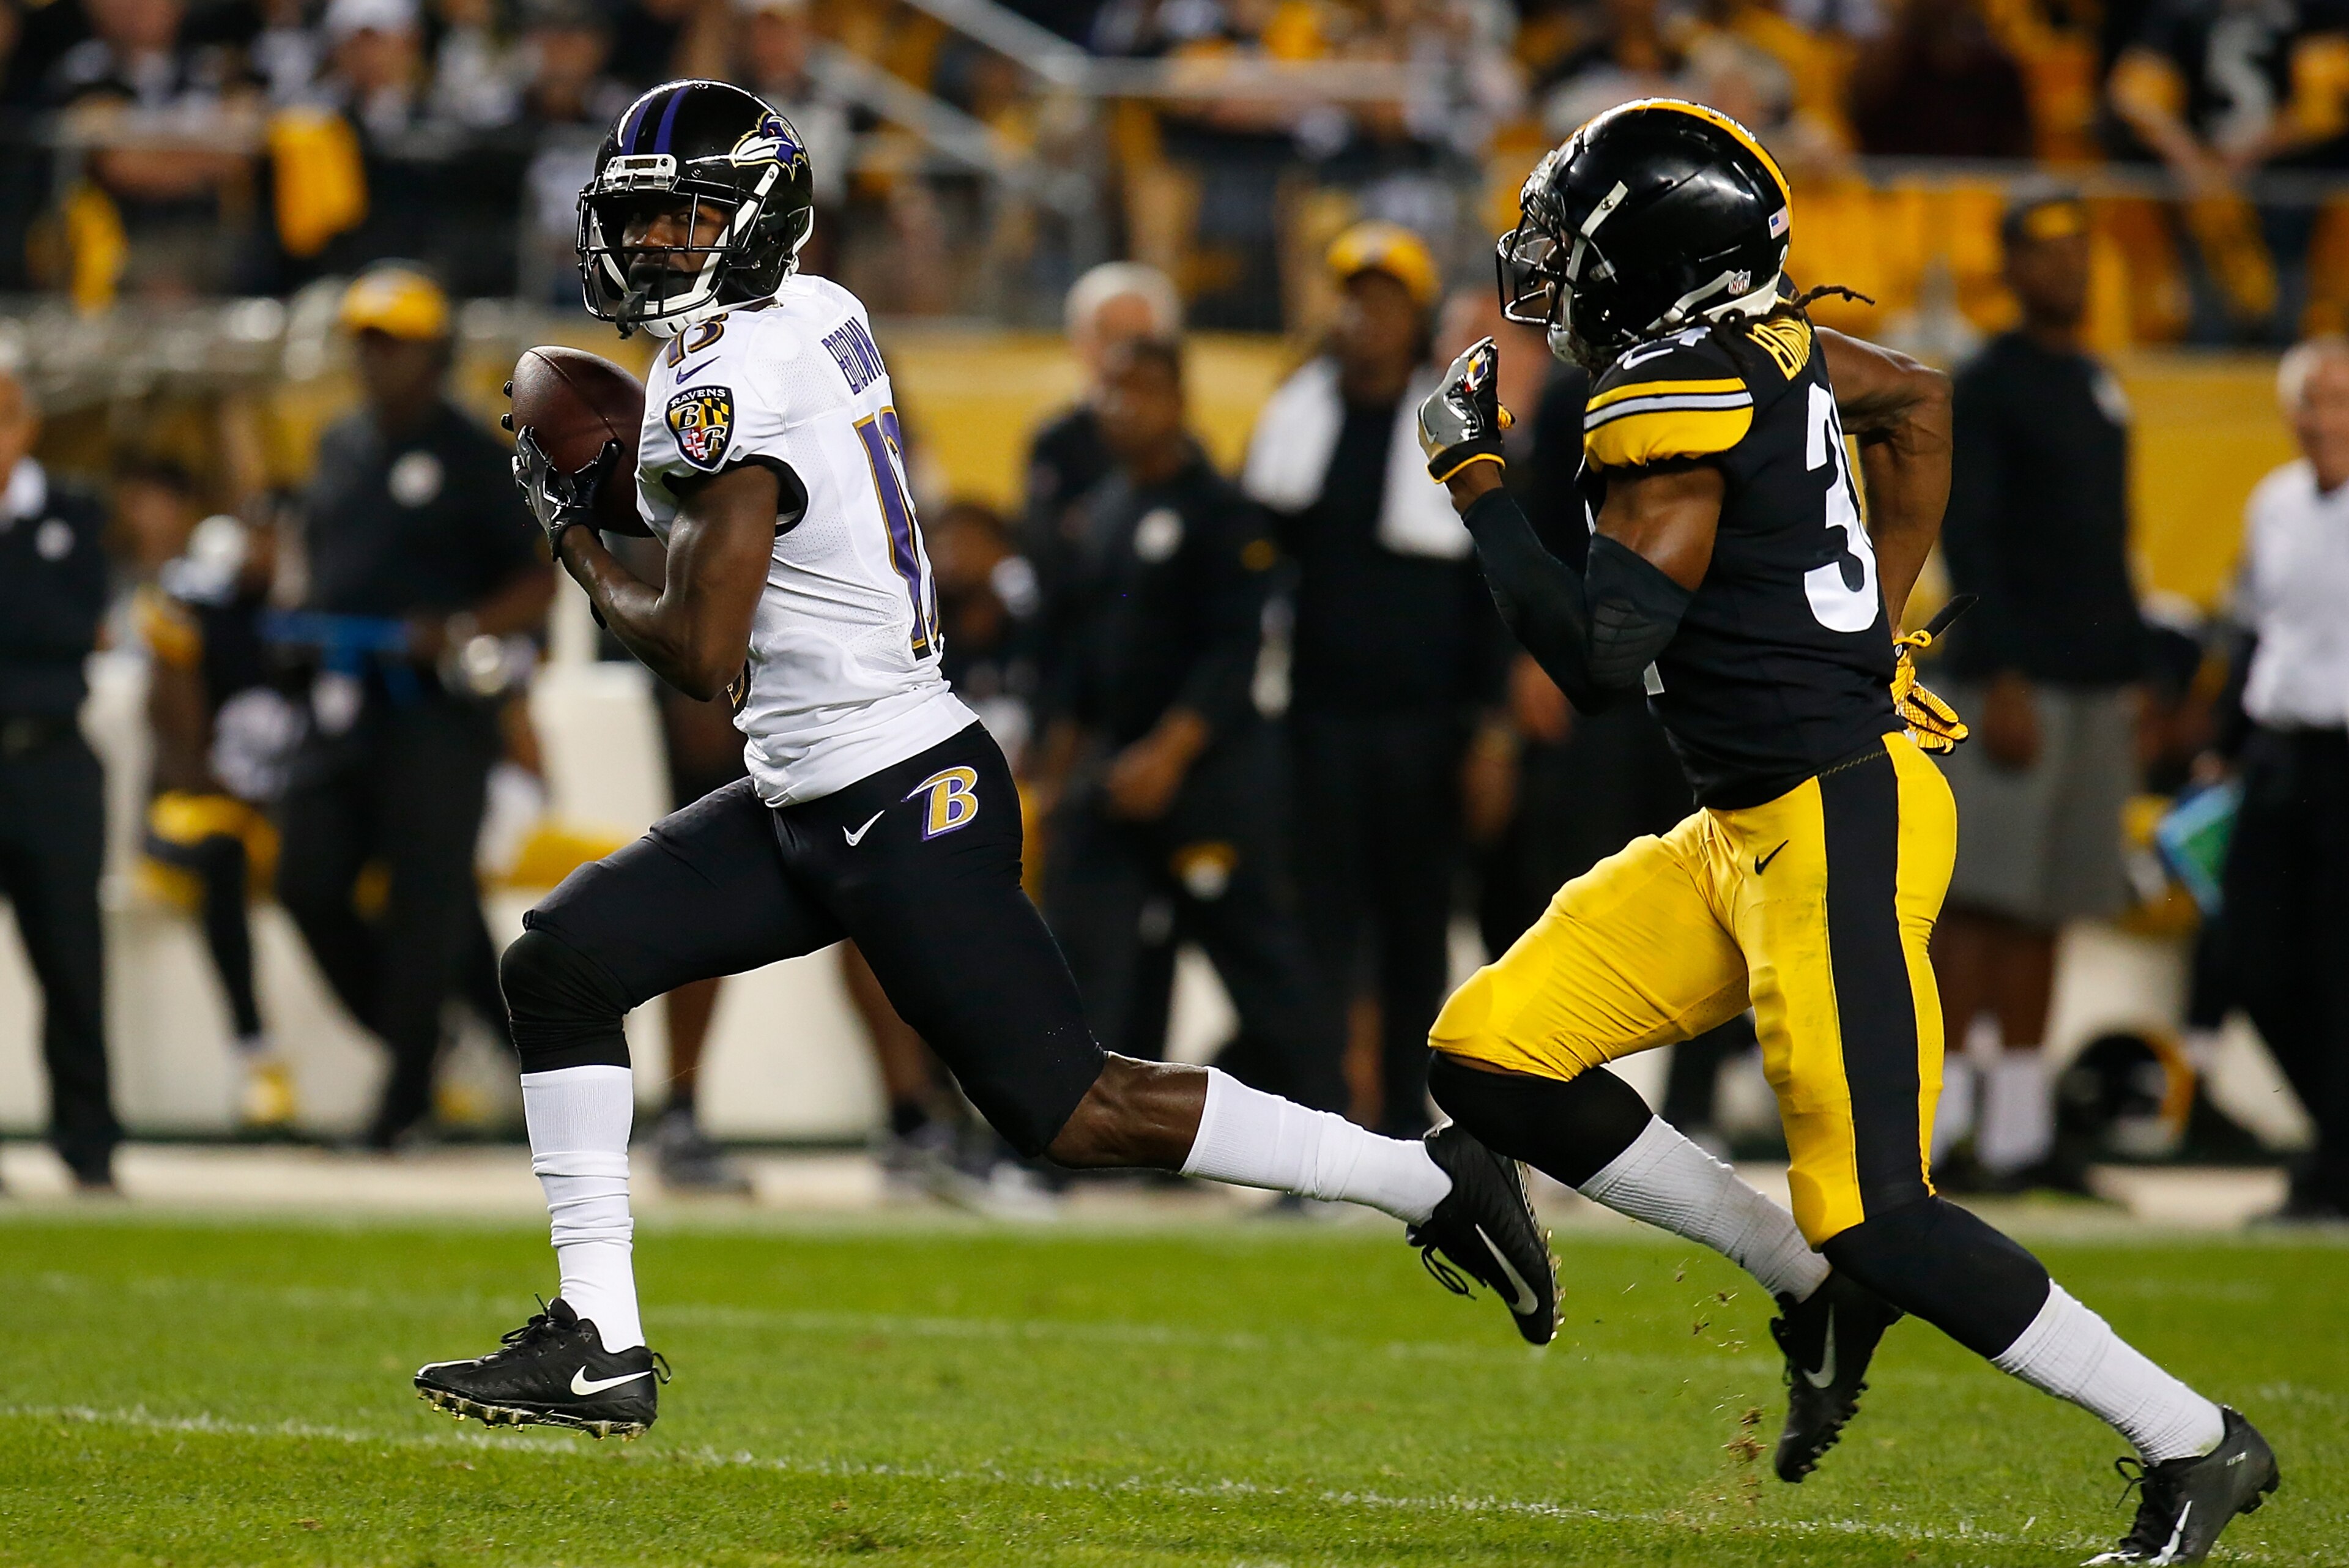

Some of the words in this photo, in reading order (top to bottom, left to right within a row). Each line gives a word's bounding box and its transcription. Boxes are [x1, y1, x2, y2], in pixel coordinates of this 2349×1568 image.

[821, 316, 884, 396] BROWN
[670, 388, 726, 407] RAVENS
[673, 403, 700, 429] B
[700, 425, 727, 451] R
[1804, 382, 1879, 632] 3
[904, 765, 979, 841] B
